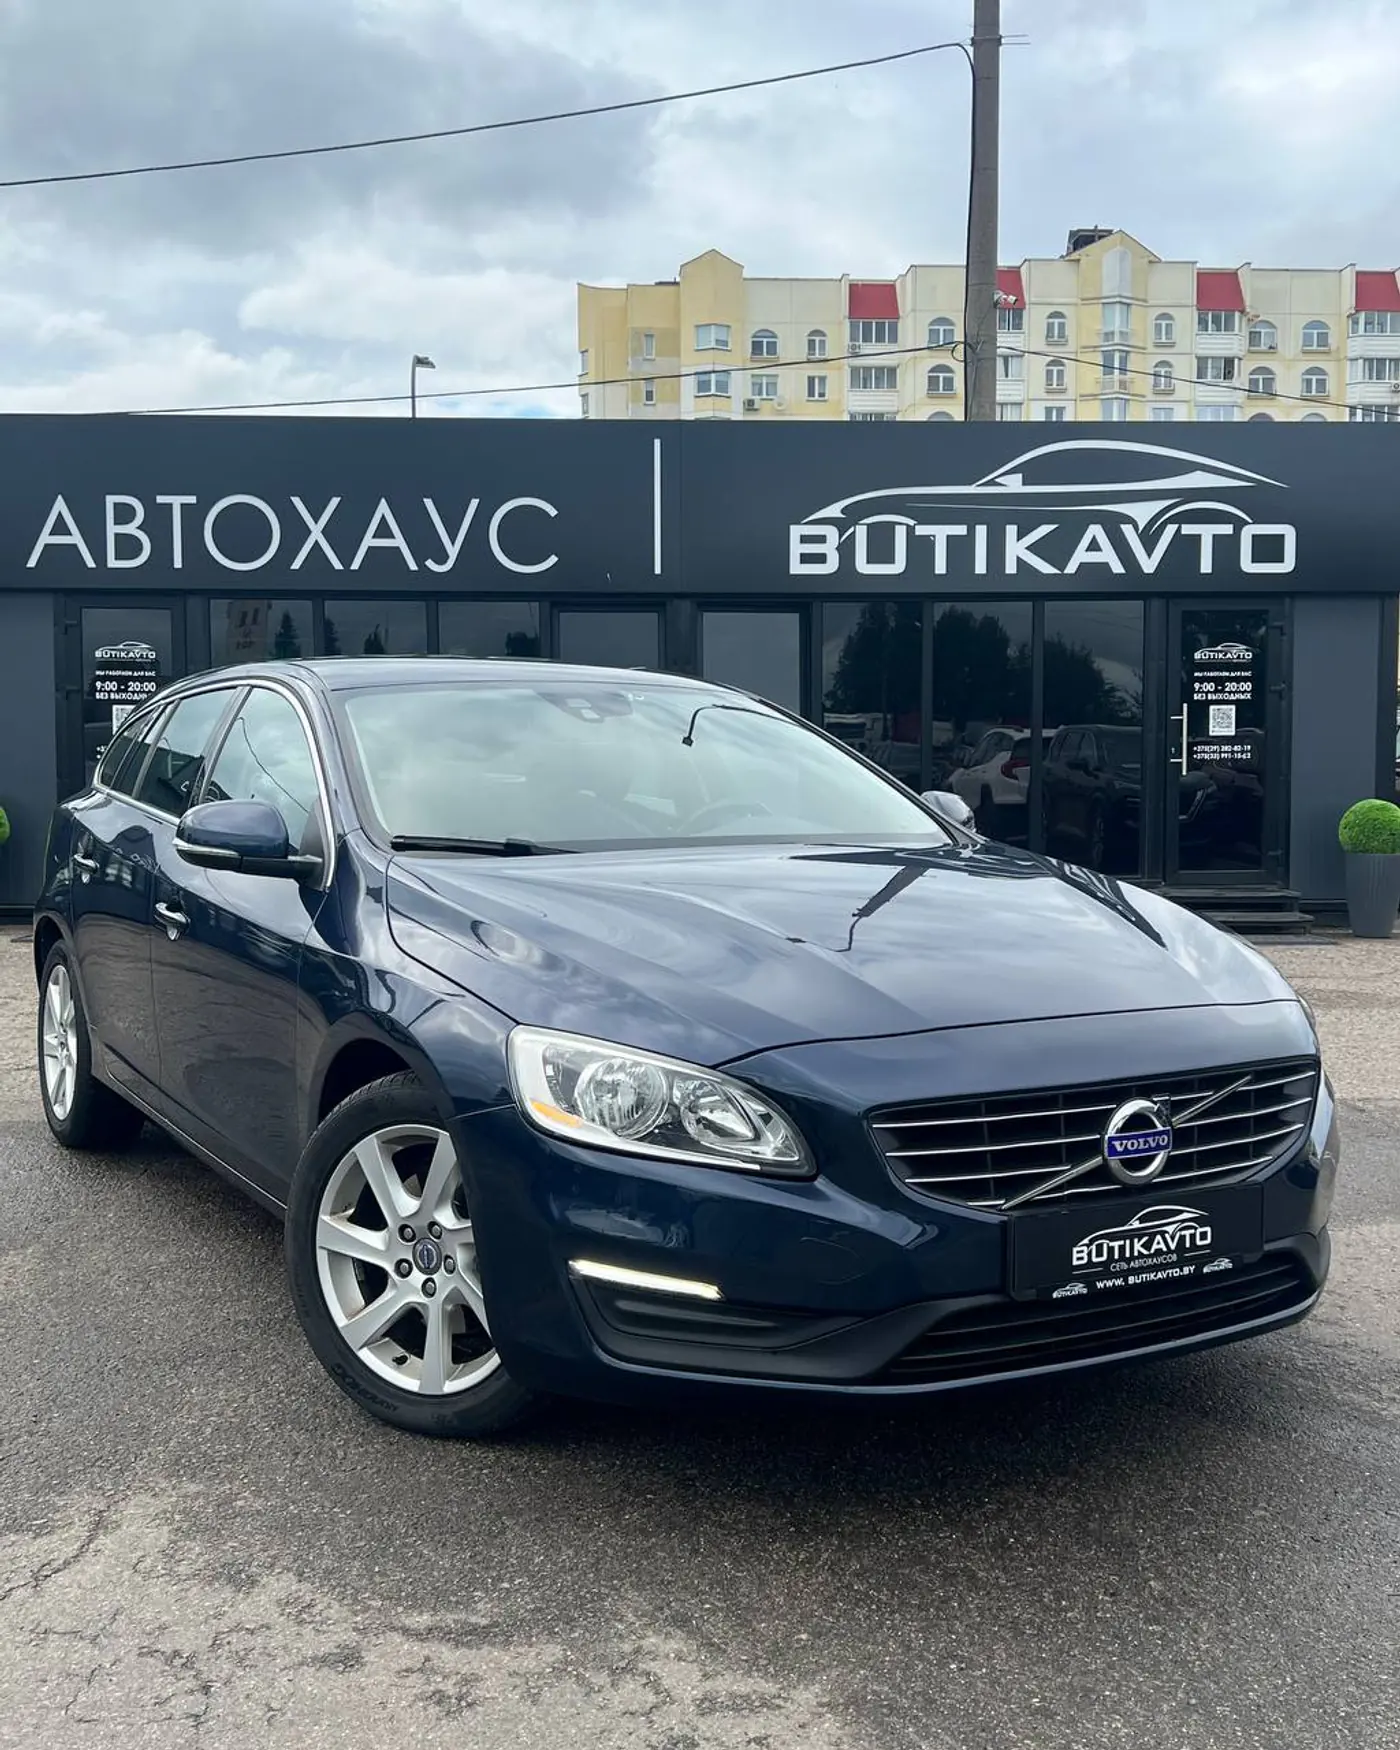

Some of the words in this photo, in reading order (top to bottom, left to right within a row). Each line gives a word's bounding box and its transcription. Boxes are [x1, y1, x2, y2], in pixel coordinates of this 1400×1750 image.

[26, 494, 559, 574] АВТОХАУС
[789, 522, 1297, 575] BUTIKAVTO
[95, 650, 156, 659] BUTIKAVTO
[1193, 651, 1253, 660] BUTIKAVTO
[95, 681, 118, 691] 9:00
[127, 681, 156, 692] 20:00
[1194, 682, 1215, 692] 9:00
[1224, 682, 1252, 692] 20:00
[1112, 1135, 1168, 1152] VOLVO
[1072, 1226, 1212, 1266] BUTIKAVTO
[1110, 1262, 1128, 1272] СЕТЬ
[1129, 1253, 1178, 1269] АВТОХАУСОВ
[1096, 1278, 1125, 1289] WWW.
[1128, 1265, 1196, 1285] BUTIKAVTO.BY
